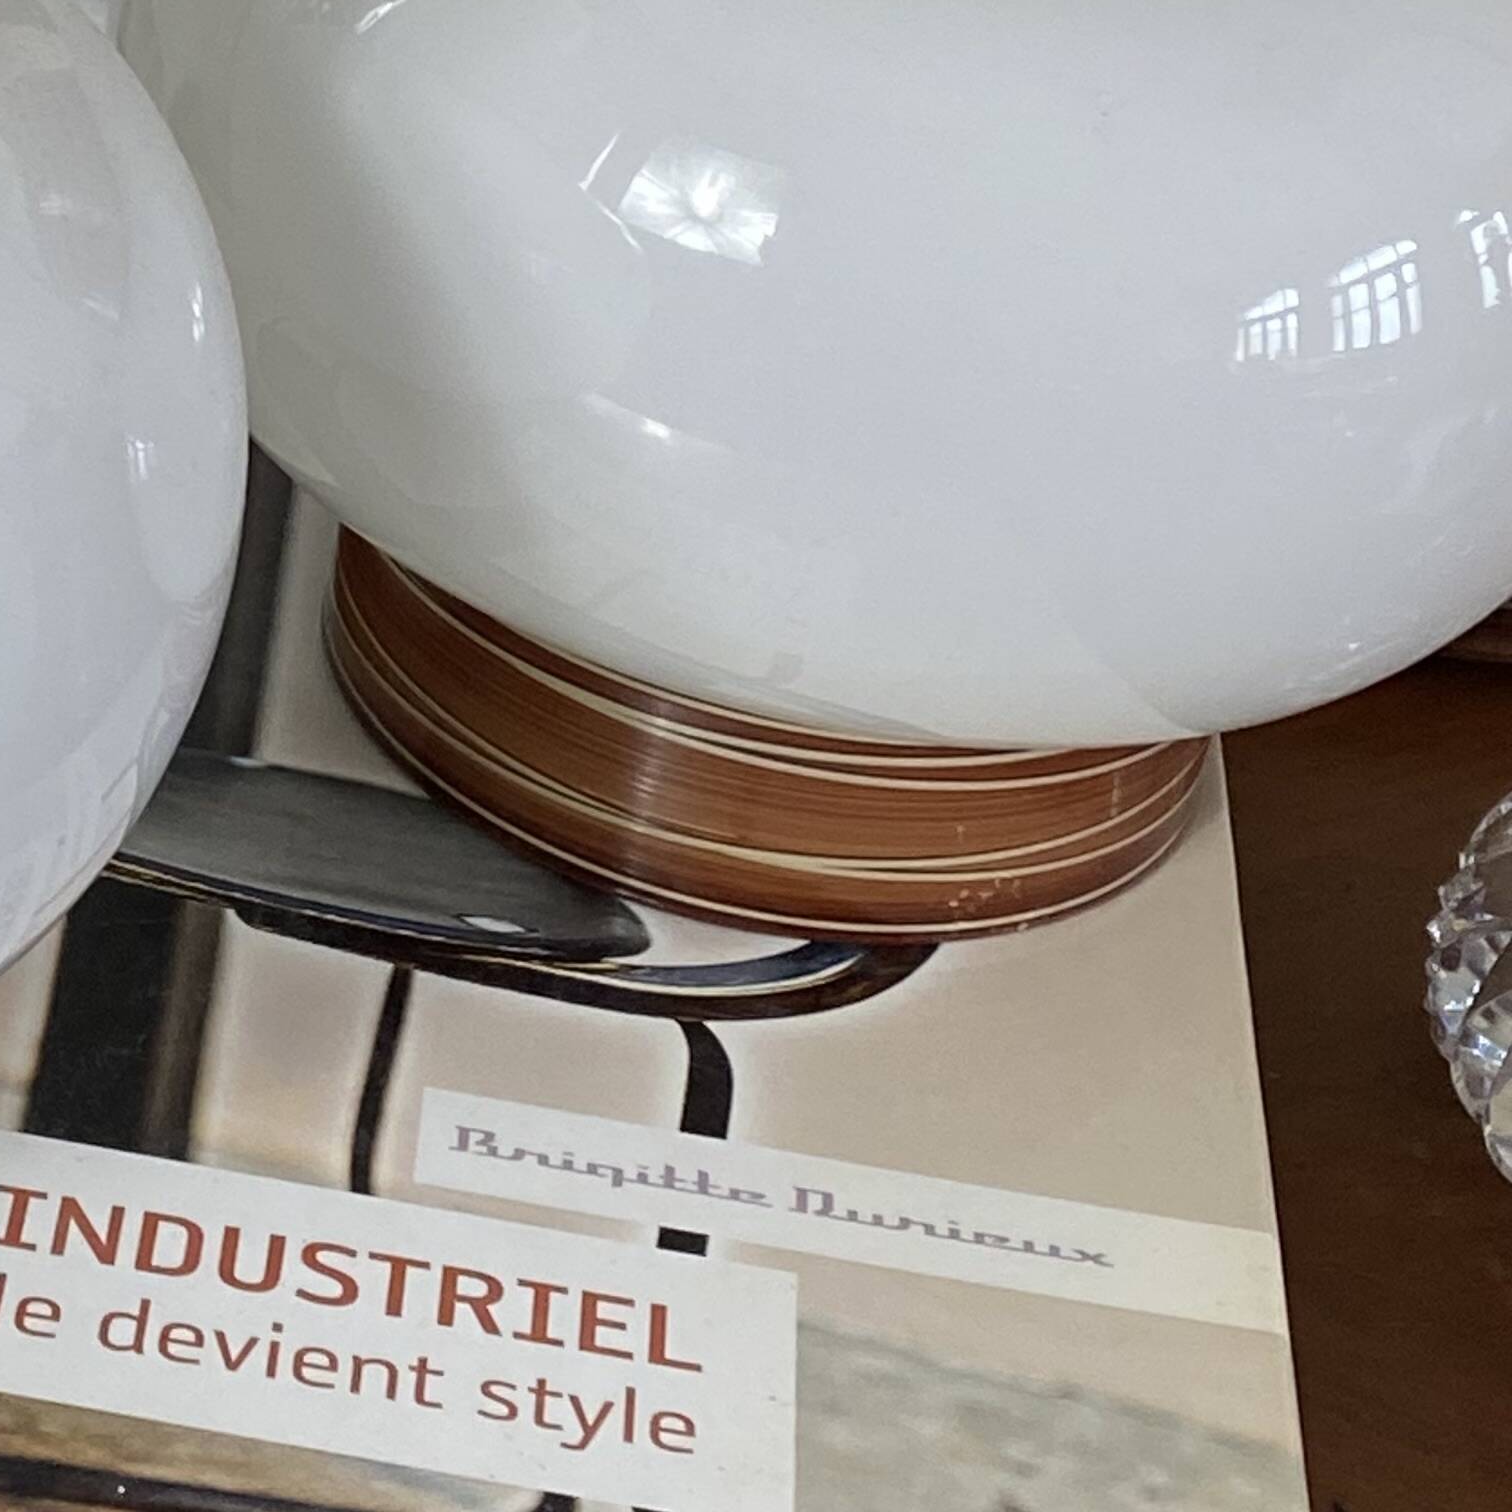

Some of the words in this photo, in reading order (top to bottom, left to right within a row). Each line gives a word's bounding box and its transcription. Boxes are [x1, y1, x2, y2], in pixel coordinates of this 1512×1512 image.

[448, 1124, 774, 1210] Brigitte
[788, 1185, 1115, 1269] Durieux
[96, 1297, 446, 1410] devient
[476, 1376, 698, 1455] style
